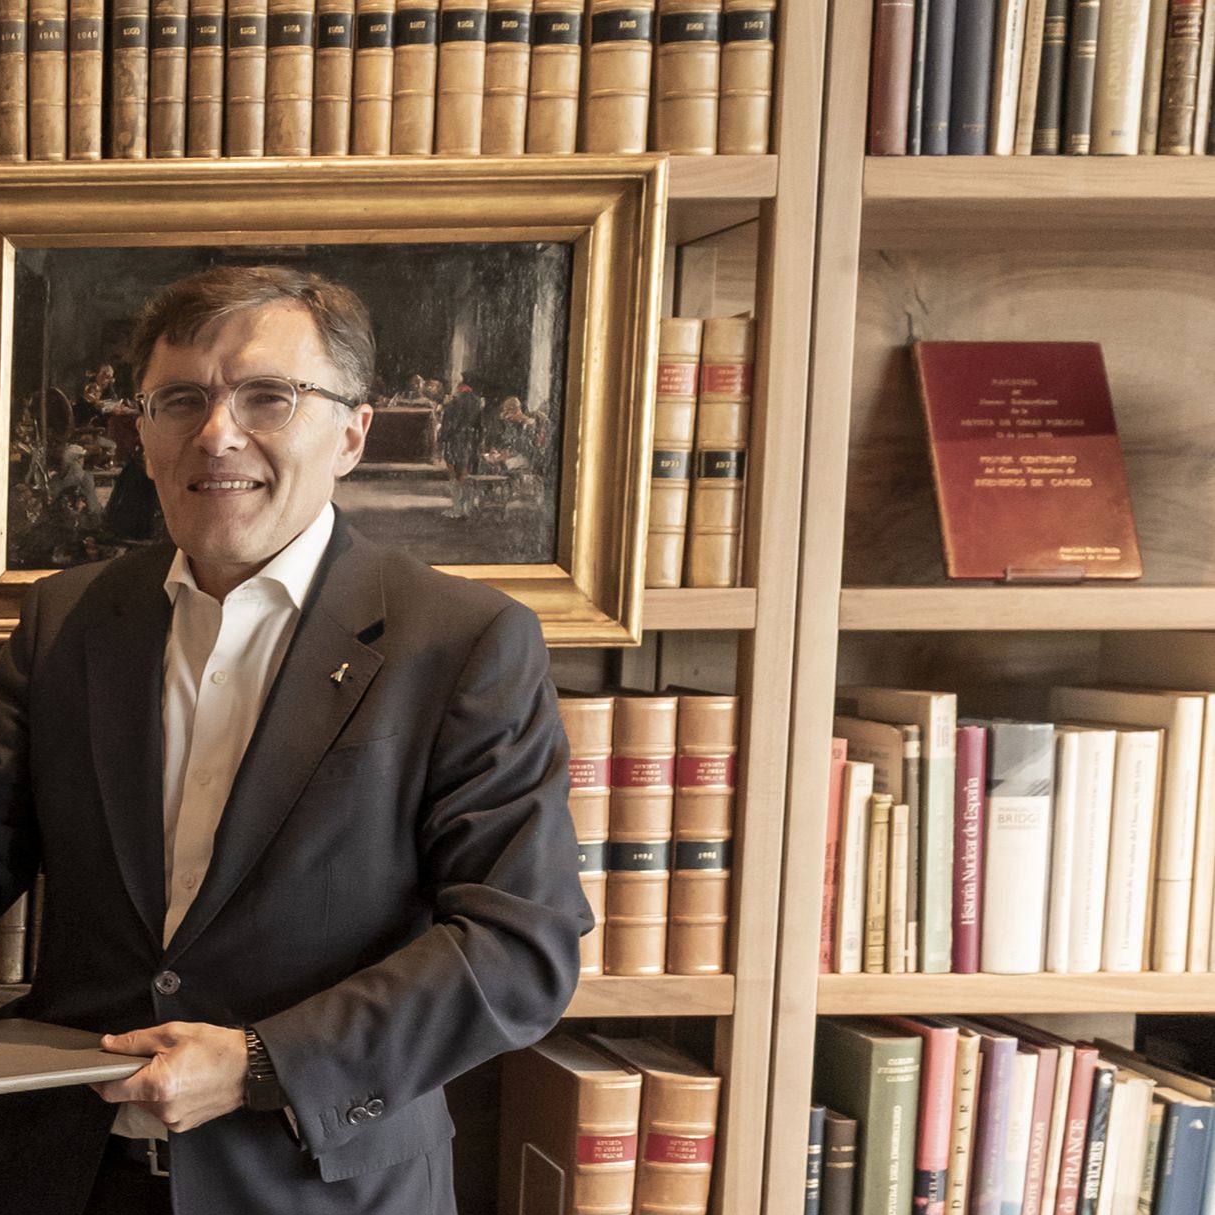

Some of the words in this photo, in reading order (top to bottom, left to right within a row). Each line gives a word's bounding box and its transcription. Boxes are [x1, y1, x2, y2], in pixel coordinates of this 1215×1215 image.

[966, 776, 980, 818] España
[967, 819, 978, 838] de
[963, 837, 977, 882] Nuclear
[961, 883, 976, 925] Historia
[891, 1105, 902, 1160] INGENIERO
[956, 1068, 971, 1155] PARIS
[889, 1162, 899, 1182] DEL
[1030, 1121, 1045, 1178] SALAZAR
[1064, 1118, 1085, 1188] FRANCE
[1085, 1140, 1104, 1199] STRUCTURES
[1059, 1196, 1075, 1214] de
